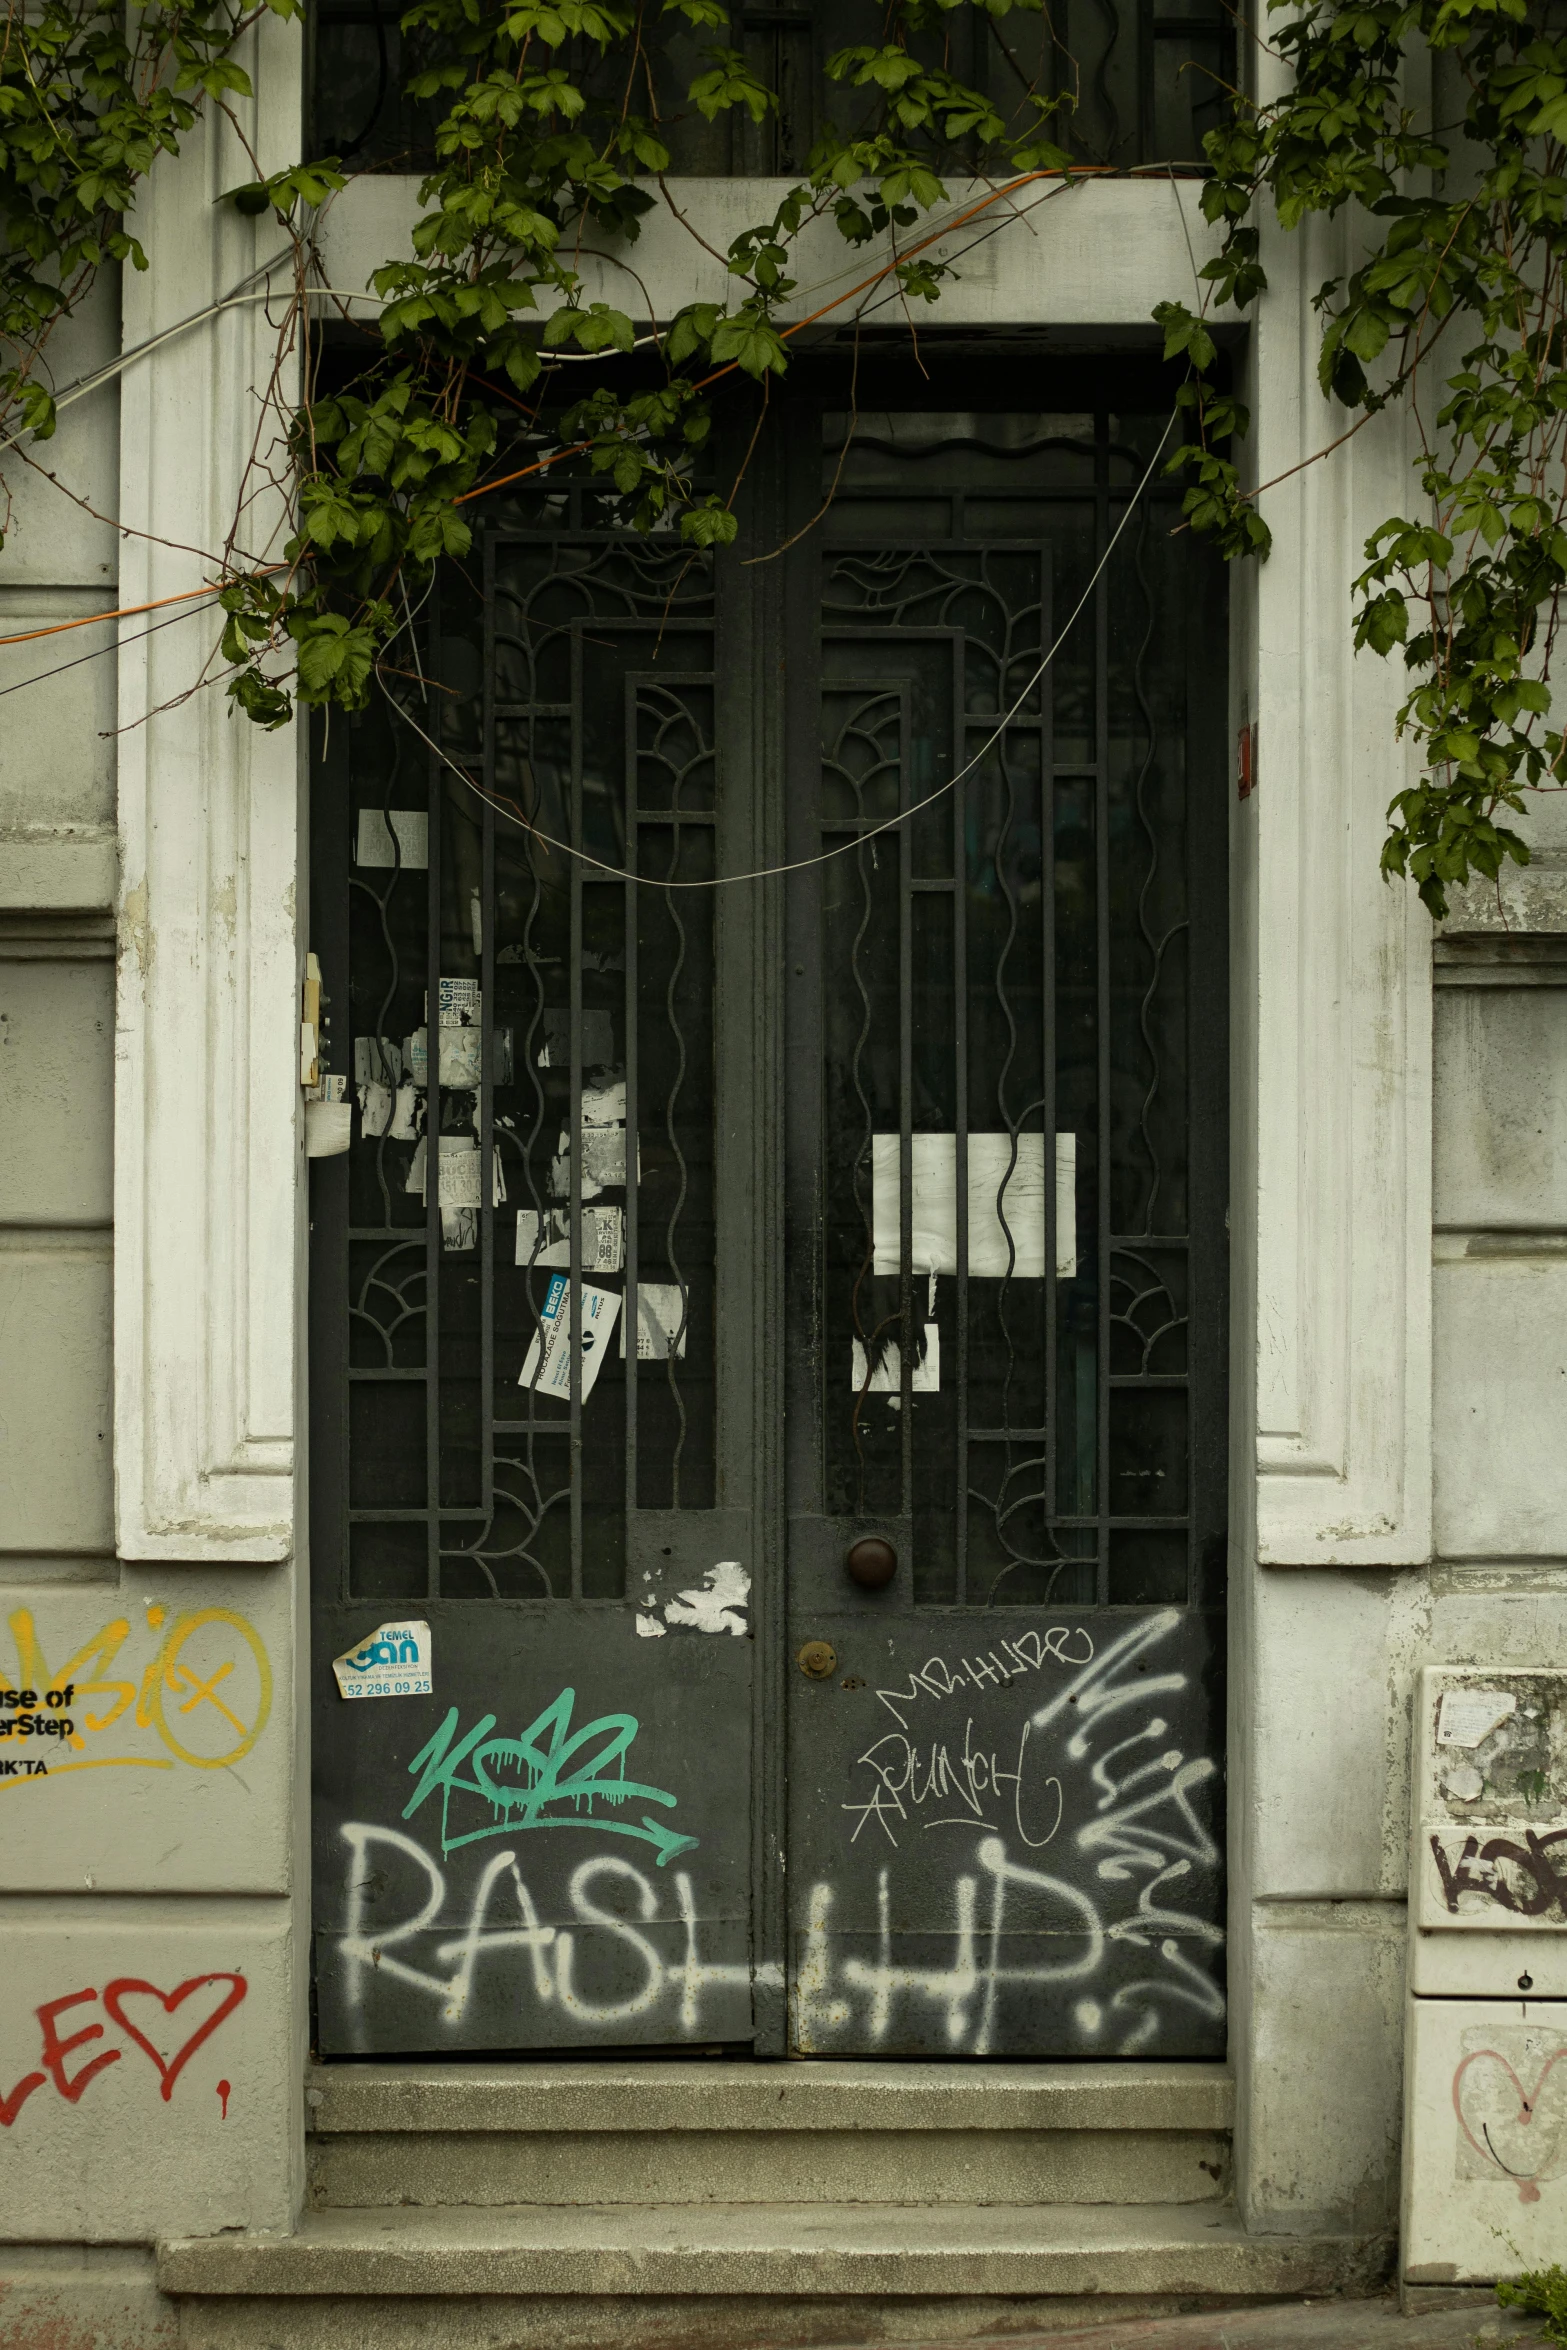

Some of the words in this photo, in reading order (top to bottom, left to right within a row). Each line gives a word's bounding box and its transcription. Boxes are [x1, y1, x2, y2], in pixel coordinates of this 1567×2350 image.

[546, 1281, 563, 1315] BEKO
[380, 1630, 415, 1641] TEMEL
[45, 1684, 75, 1709] of
[366, 1682, 391, 1696] 296
[394, 1681, 411, 1694] 09
[414, 1680, 431, 1693] 25
